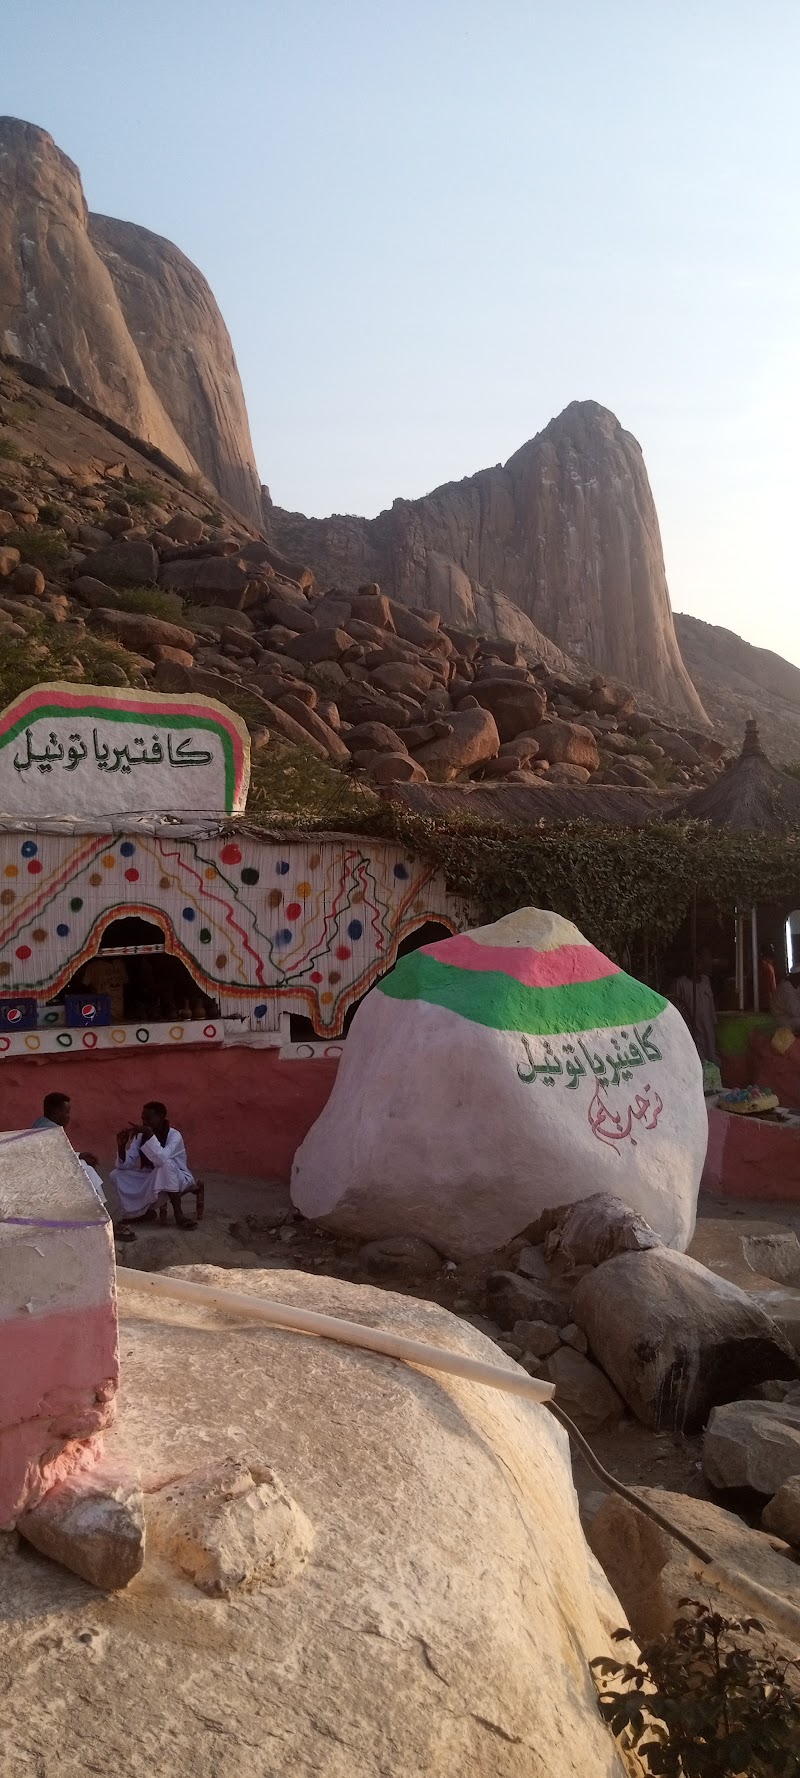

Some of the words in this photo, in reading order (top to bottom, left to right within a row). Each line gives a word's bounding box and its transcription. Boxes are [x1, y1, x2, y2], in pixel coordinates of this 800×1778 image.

[13, 728, 88, 773] توتيل
[92, 728, 213, 774] كافتيريا
[517, 1034, 586, 1089] توتيل
[577, 1024, 662, 1088] كافتيريا
[588, 1075, 623, 1156] بكم
